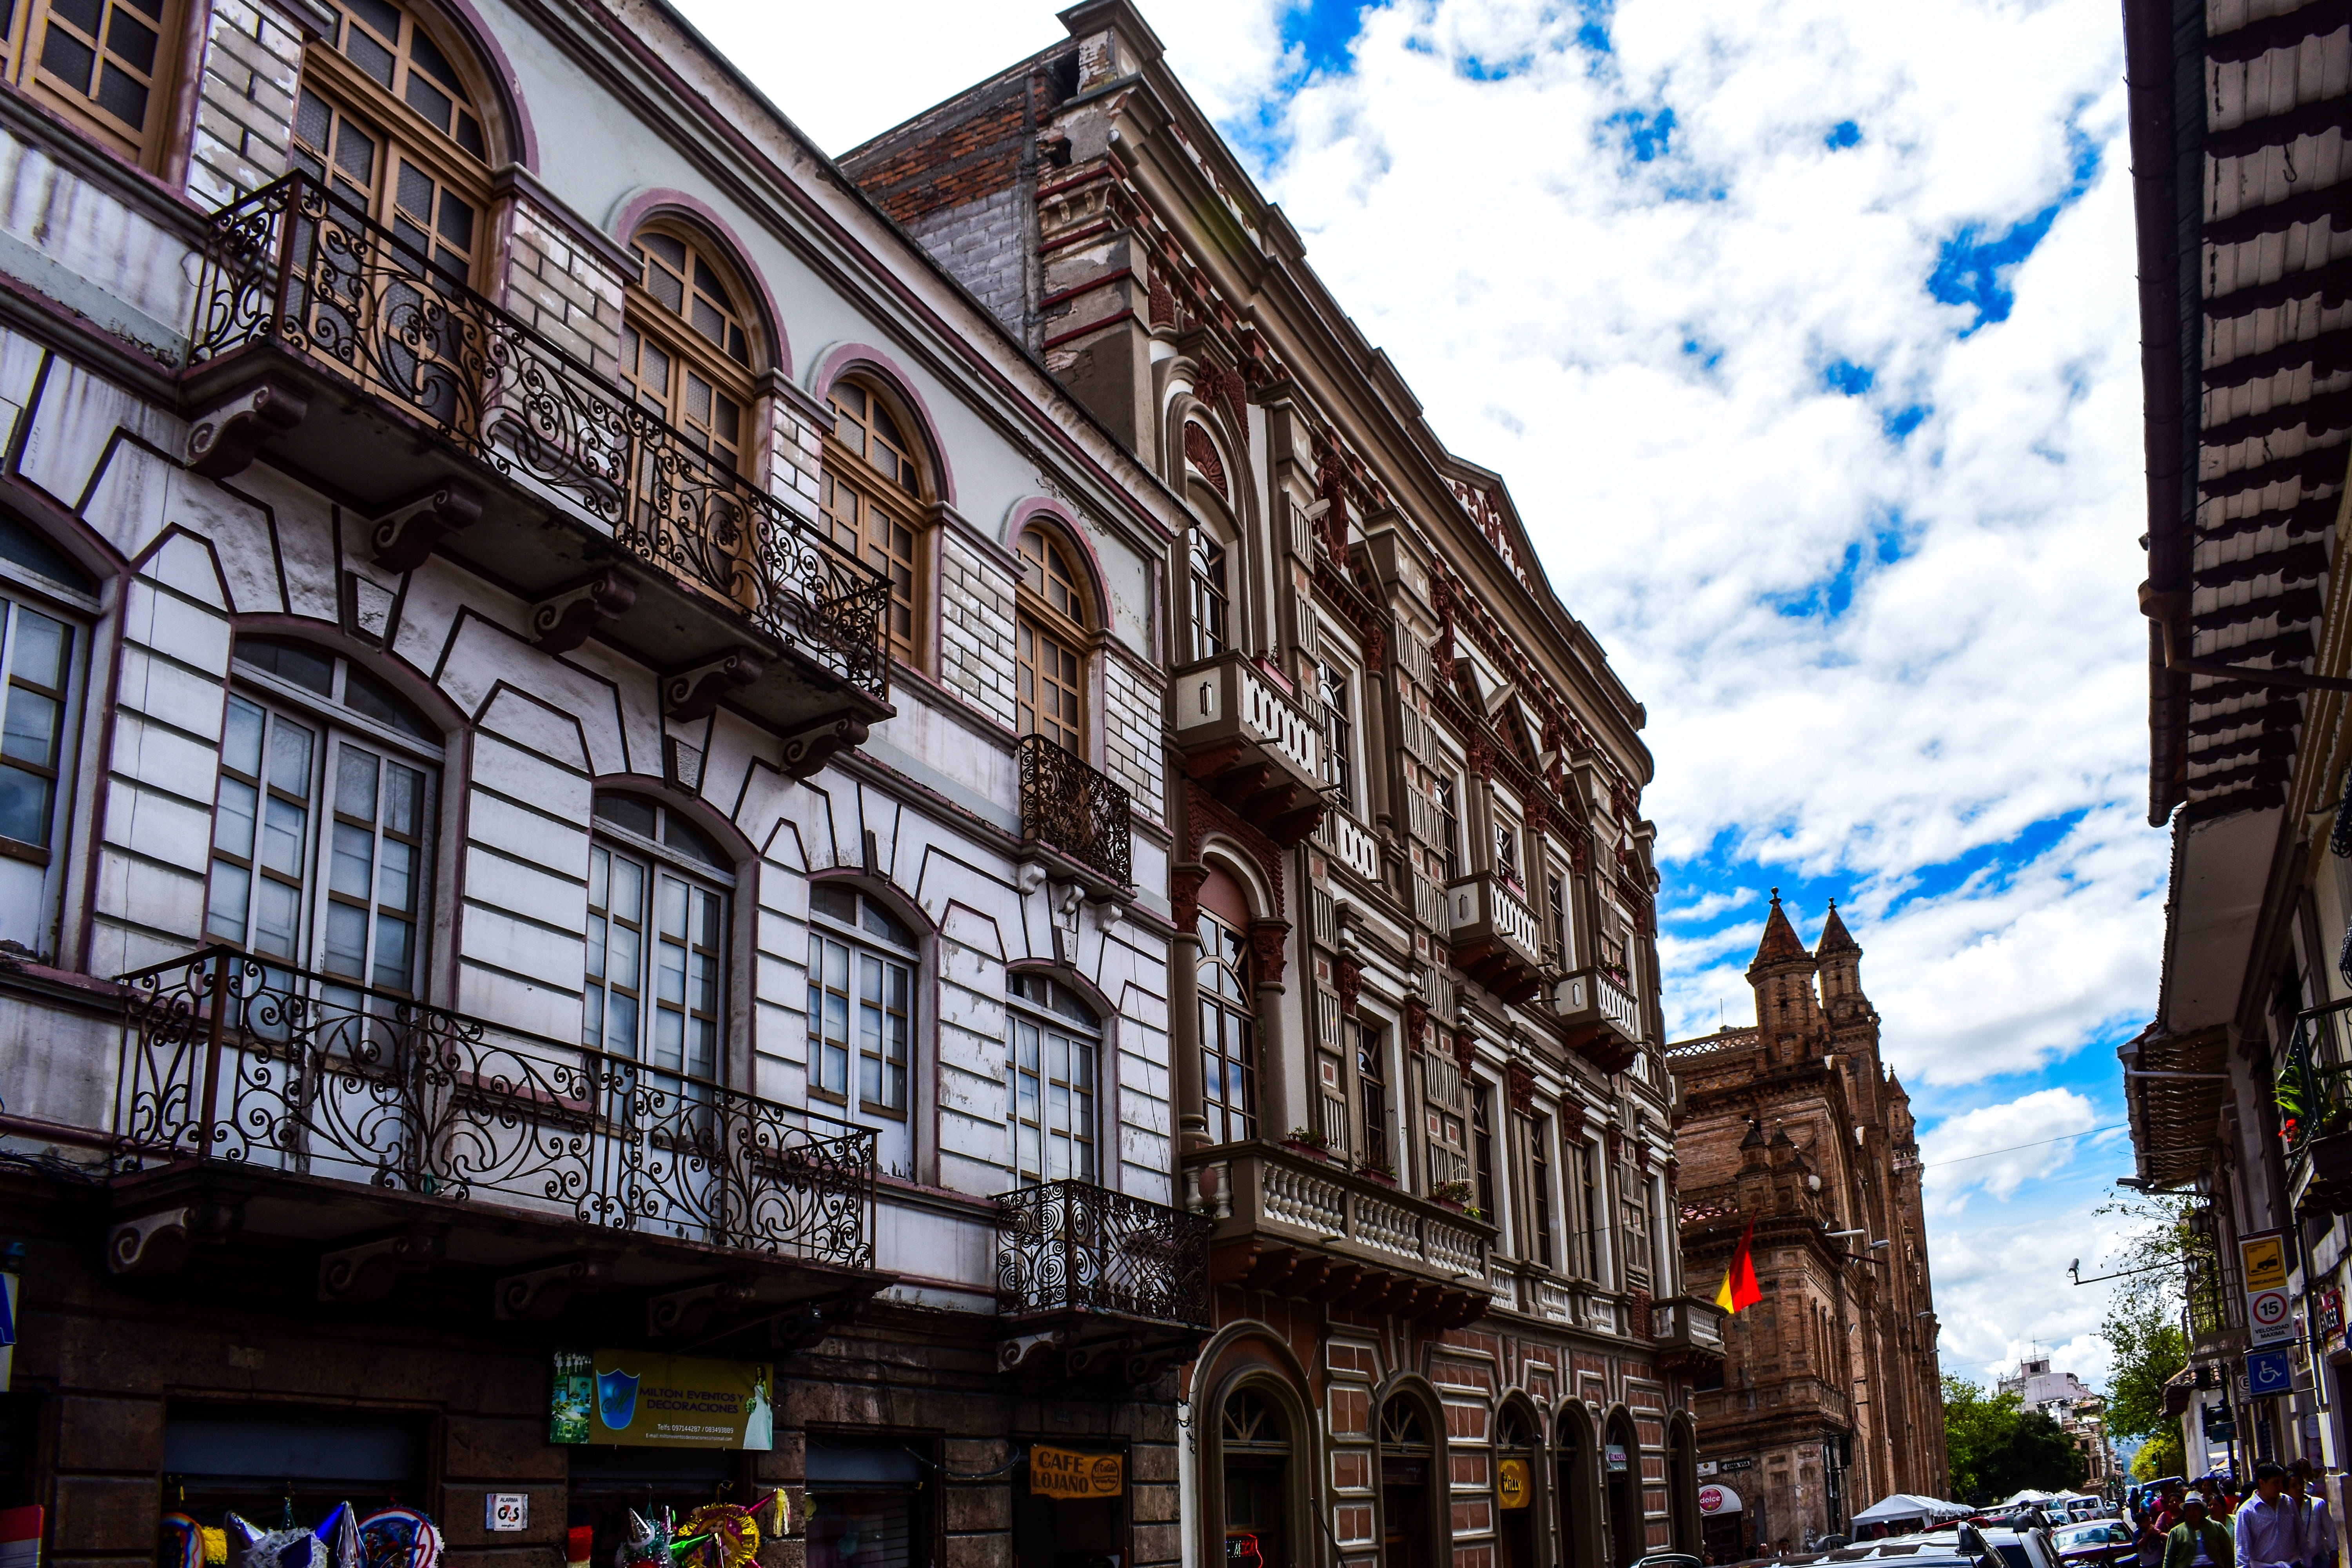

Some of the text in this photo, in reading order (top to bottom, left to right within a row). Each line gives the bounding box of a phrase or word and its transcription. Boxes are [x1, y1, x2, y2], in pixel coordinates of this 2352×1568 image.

[2249, 1276, 2283, 1286] PRECAUCION
[2261, 1301, 2279, 1316] 15
[2255, 1324, 2289, 1334] VELOCIDAD
[2261, 1330, 2285, 1339] MAXIMA
[639, 1388, 744, 1402] MILTON EVENTOS Y
[647, 1399, 738, 1413] DECORACIONES
[1038, 1451, 1083, 1474] CAFE
[1031, 1470, 1089, 1493] LOJANO
[1700, 1495, 1720, 1504] dolce
